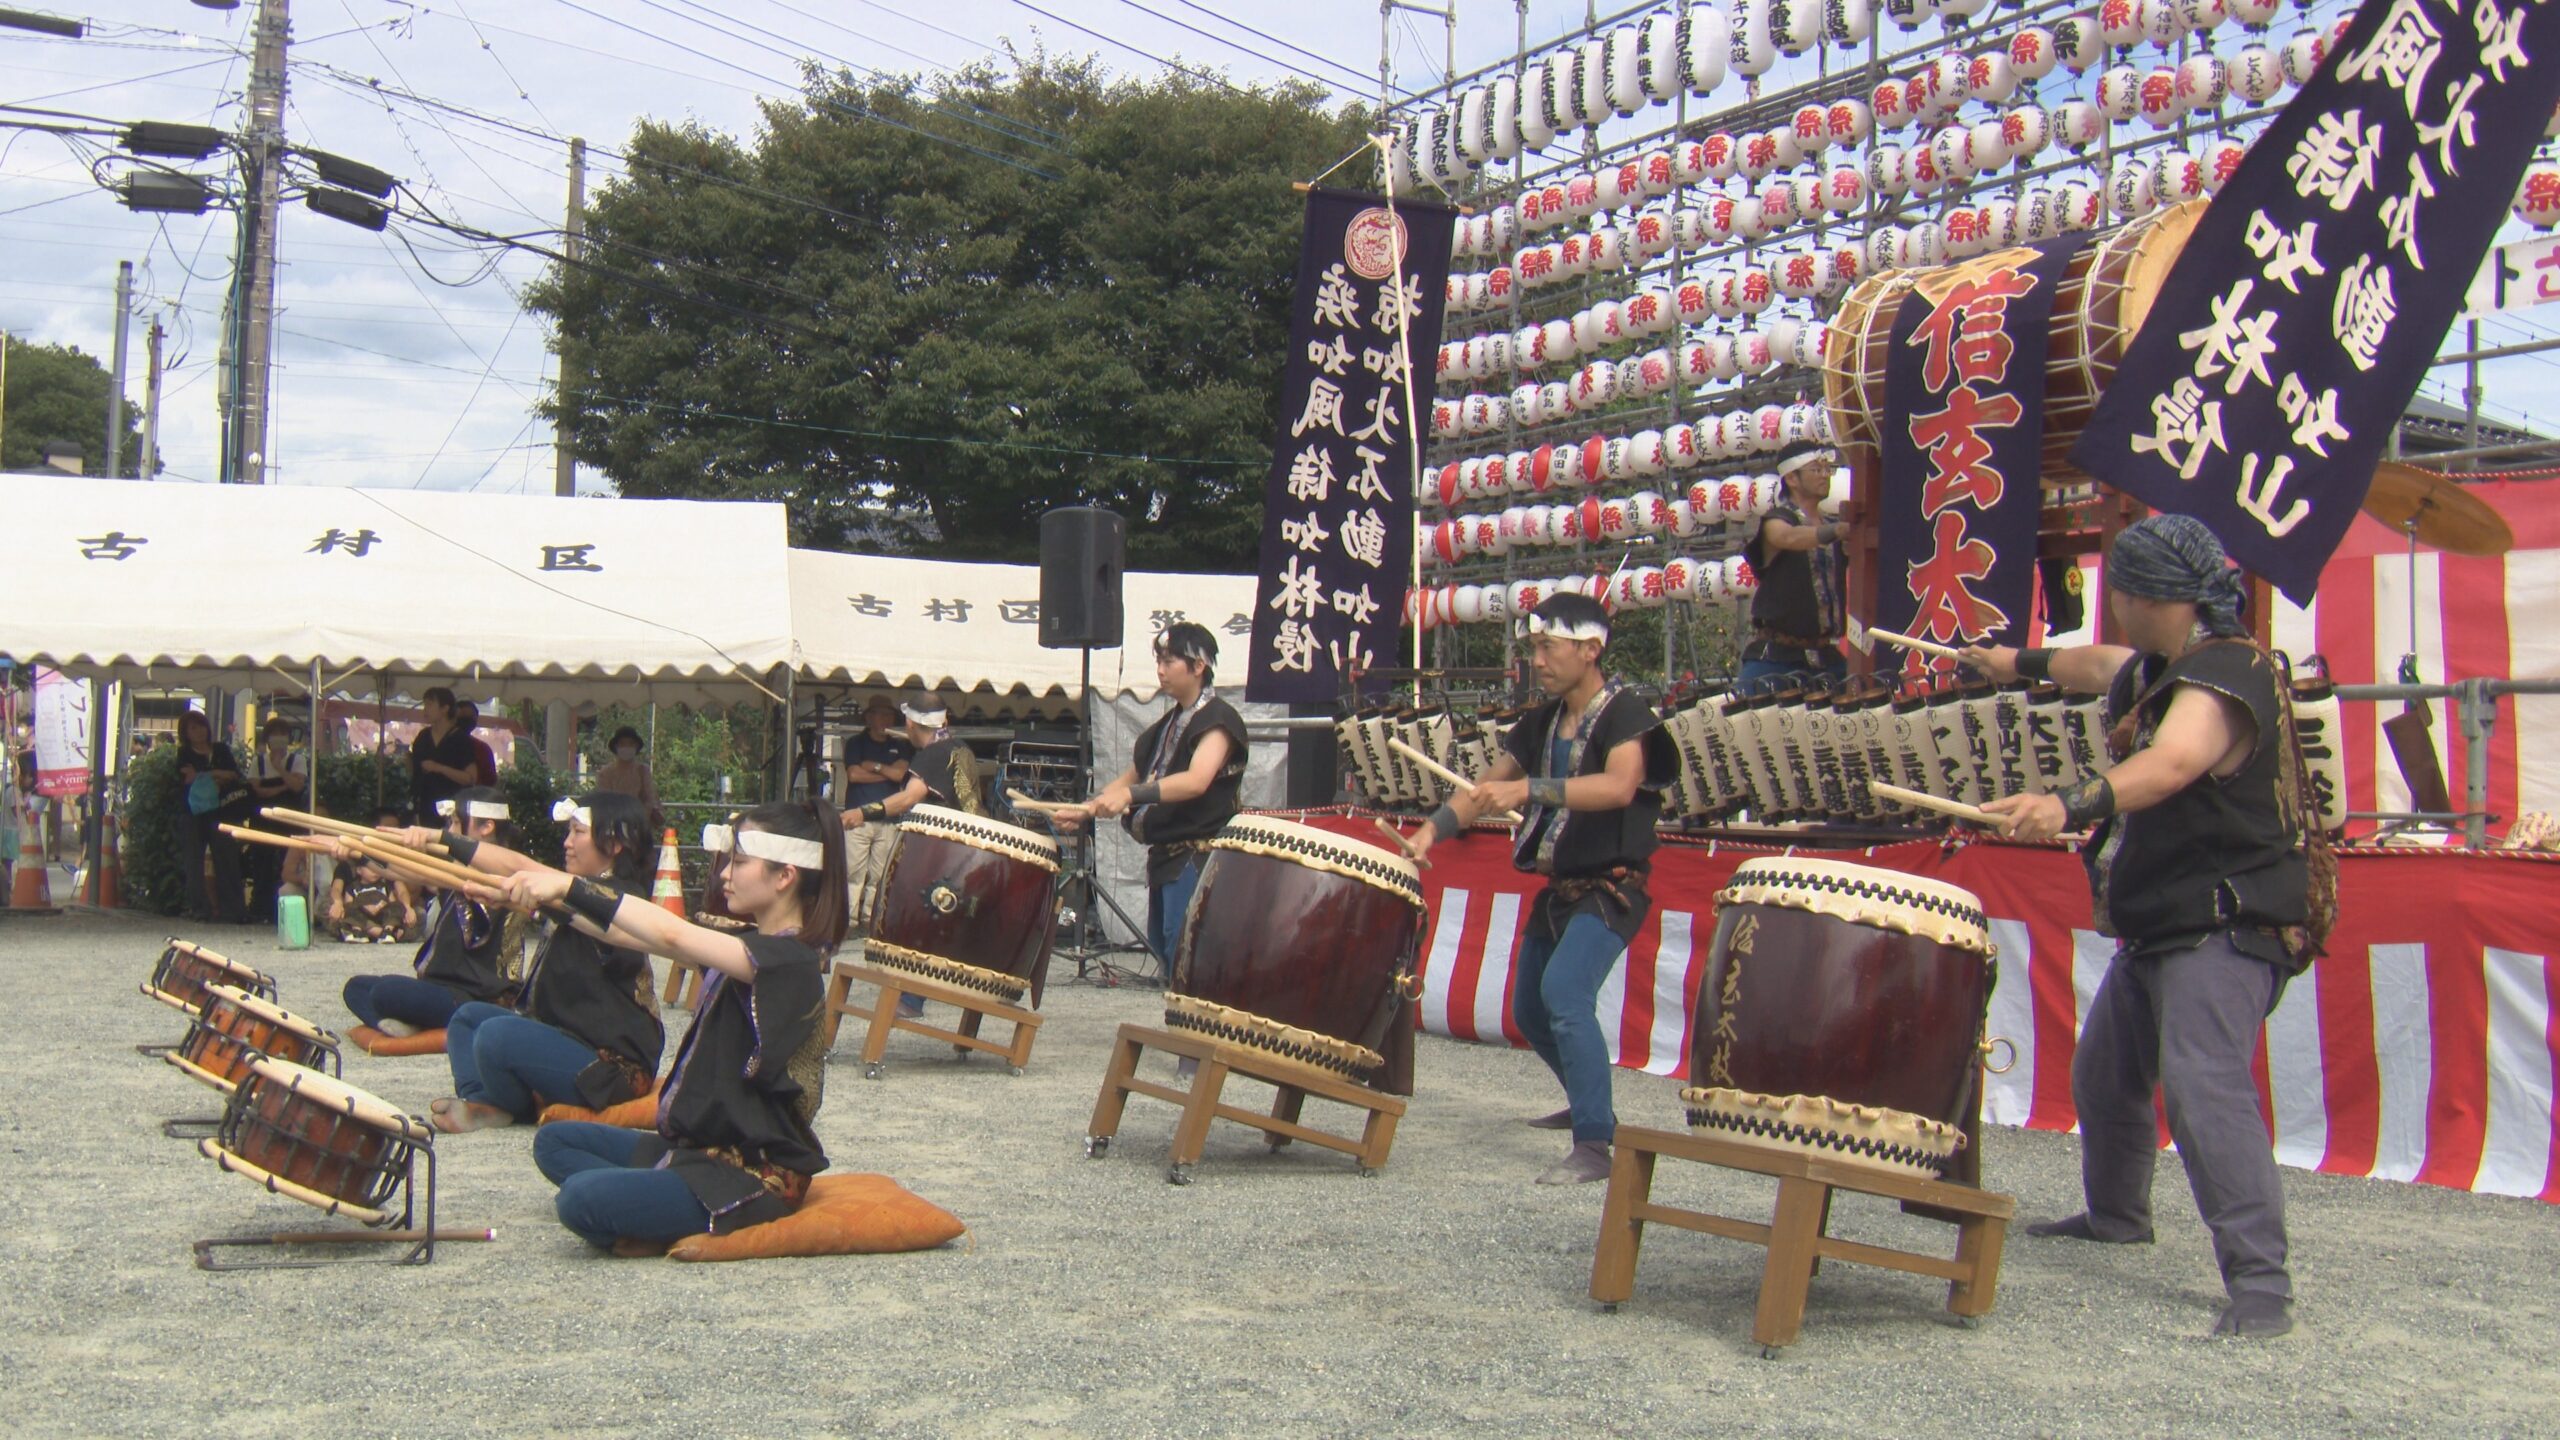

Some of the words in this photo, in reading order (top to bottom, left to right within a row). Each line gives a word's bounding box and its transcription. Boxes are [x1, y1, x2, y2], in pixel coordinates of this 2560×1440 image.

[2102, 0, 2130, 33] 祭
[2010, 32, 2040, 65] 祭
[2052, 20, 2080, 60] 祭
[1967, 57, 1991, 91] 祭
[2176, 66, 2196, 100] 祭
[1873, 85, 1899, 118] 祭
[1905, 77, 1926, 115] 祭
[2141, 74, 2174, 115] 祭
[1796, 109, 1822, 140] 祭
[1827, 105, 1854, 138] 祭
[2002, 113, 2026, 147] 祭
[1702, 135, 1729, 169] 祭
[1746, 138, 1764, 169] 祭
[1617, 163, 1640, 196] 祭
[1648, 155, 1671, 185] 祭
[1831, 170, 1861, 200] 祭
[2180, 160, 2201, 196] 祭
[1540, 188, 1564, 214] 祭
[1567, 180, 1592, 207] 祭
[1762, 188, 1788, 217] 祭
[2523, 171, 2560, 214] 祭
[1636, 216, 1661, 245] 祭
[1713, 198, 1734, 234] 祭
[1946, 209, 1976, 243] 祭
[1536, 249, 1553, 276] 祭
[1561, 238, 1581, 266] 祭
[1588, 233, 1604, 263] 祭
[1519, 252, 1538, 280] 祭
[1786, 255, 1815, 290] 祭
[1835, 250, 1858, 282] 祭
[1488, 269, 1512, 297] 祭
[1742, 271, 1771, 305] 祭
[1639, 293, 1657, 322] 祭
[1678, 284, 1705, 314] 祭
[1689, 346, 1706, 376] 祭
[1749, 335, 1771, 367] 祭
[1639, 356, 1666, 387] 祭
[1435, 405, 1451, 432] 祭
[1759, 409, 1782, 443] 祭
[1677, 426, 1694, 458] 祭
[1485, 458, 1505, 489] 祭
[1651, 497, 1668, 526] 祭
[1688, 485, 1707, 515] 祭
[1718, 482, 1740, 514] 祭
[1475, 520, 1496, 549] 祭
[1499, 514, 1517, 539] 祭
[1522, 511, 1540, 540] 祭
[1561, 509, 1577, 541] 祭
[1600, 504, 1624, 535] 祭
[77, 528, 604, 573] 古村区
[1641, 570, 1665, 600] 祭
[1662, 561, 1687, 594] 祭
[1735, 560, 1760, 590] 祭
[1518, 585, 1540, 615] 祭
